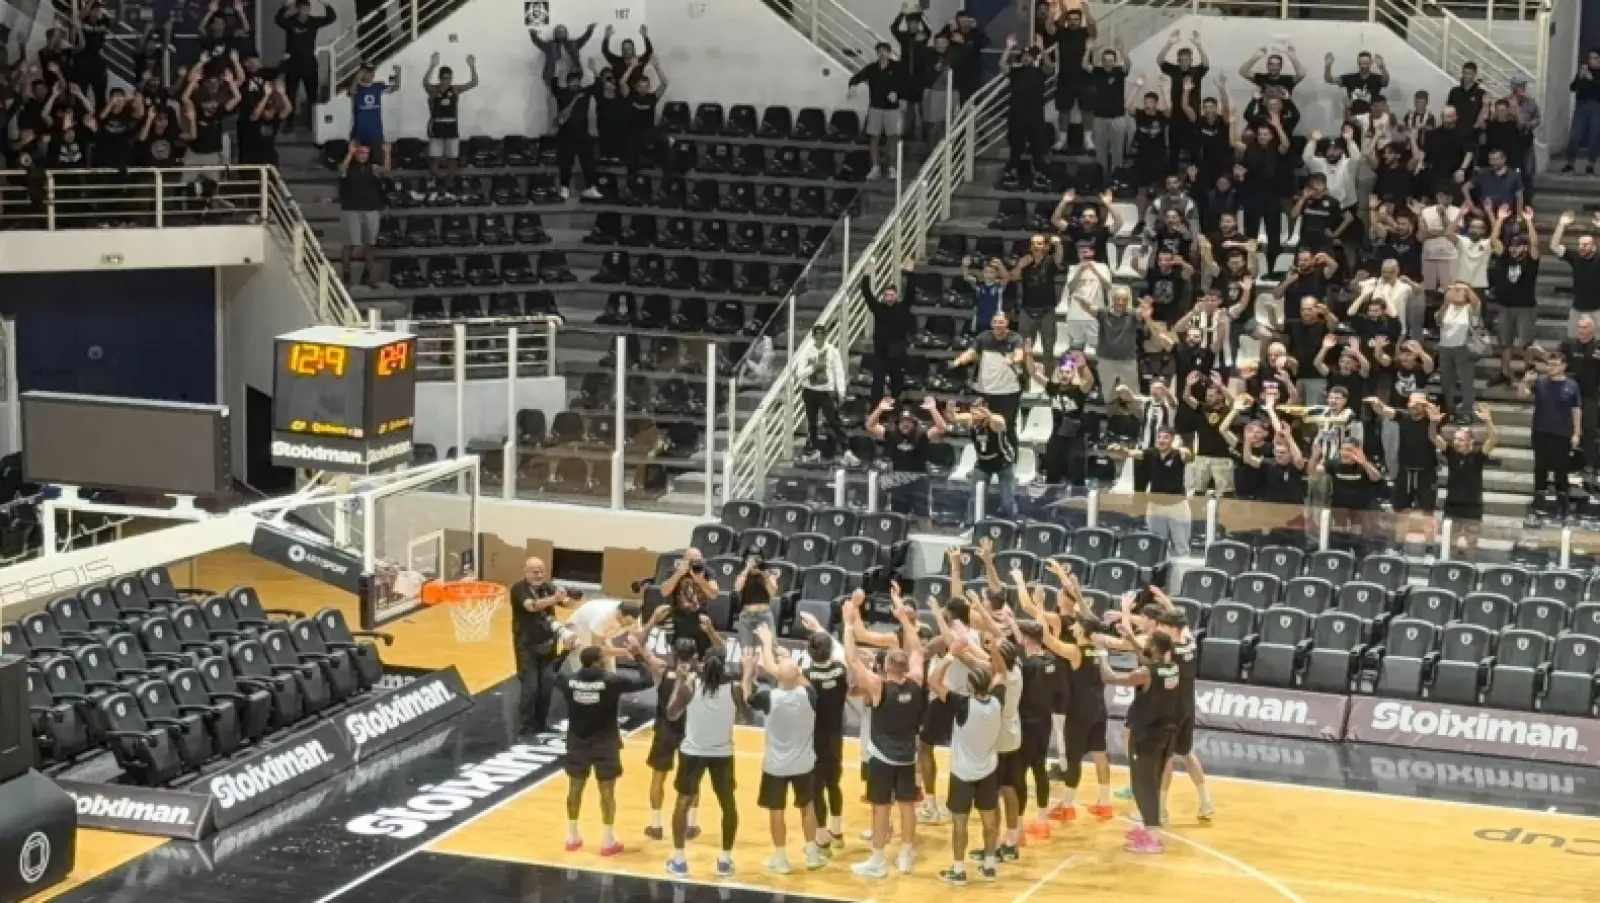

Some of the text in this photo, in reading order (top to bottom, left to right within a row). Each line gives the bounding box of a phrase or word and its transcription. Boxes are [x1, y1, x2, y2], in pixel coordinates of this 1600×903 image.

[346, 679, 457, 744] Stoiximan
[1371, 702, 1579, 750] Stoiximan
[210, 739, 328, 808] Stoiximan
